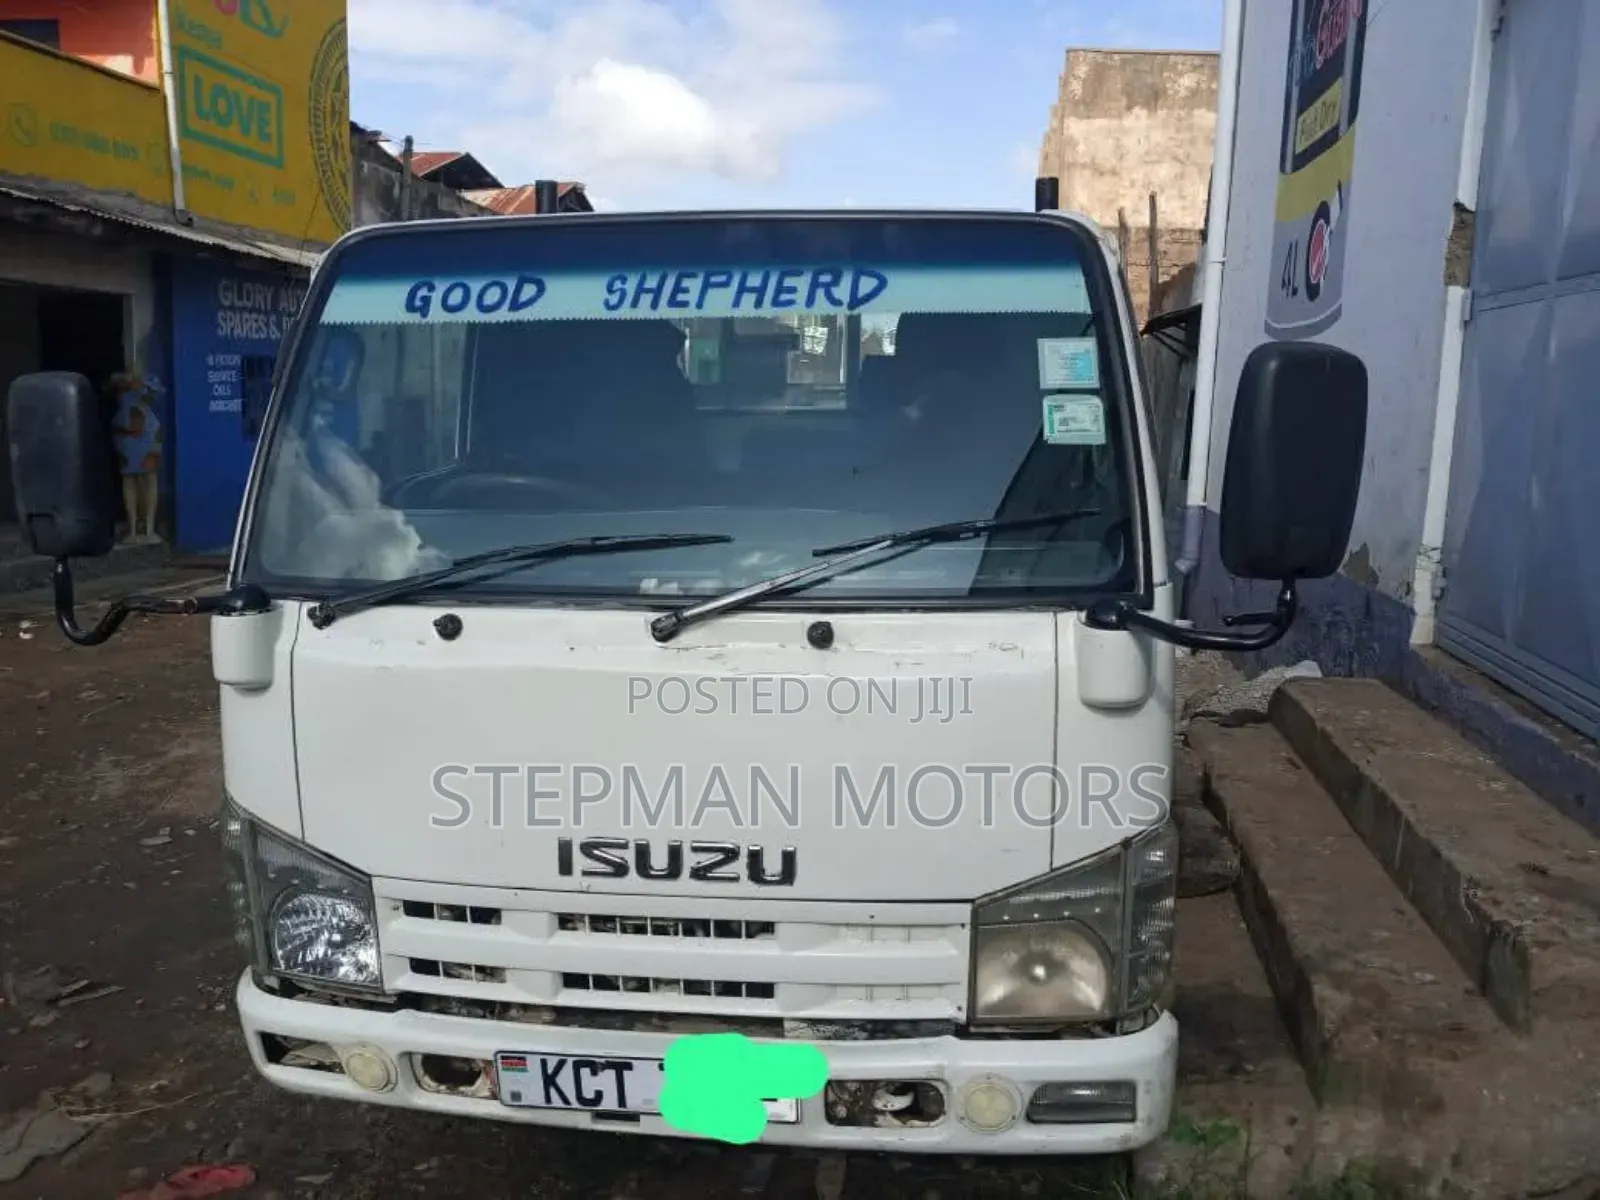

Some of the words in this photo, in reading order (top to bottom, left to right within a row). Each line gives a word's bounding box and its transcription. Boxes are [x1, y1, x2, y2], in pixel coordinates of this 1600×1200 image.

[193, 73, 272, 143] LOVE
[405, 274, 546, 318] GOOD
[603, 267, 888, 311] SHEPHERD
[1281, 240, 1298, 298] 4L
[218, 279, 274, 311] GLORY
[217, 309, 267, 340] SPARES
[269, 315, 281, 340] &
[558, 837, 796, 886] ISUZU
[540, 1057, 633, 1109] KCT
